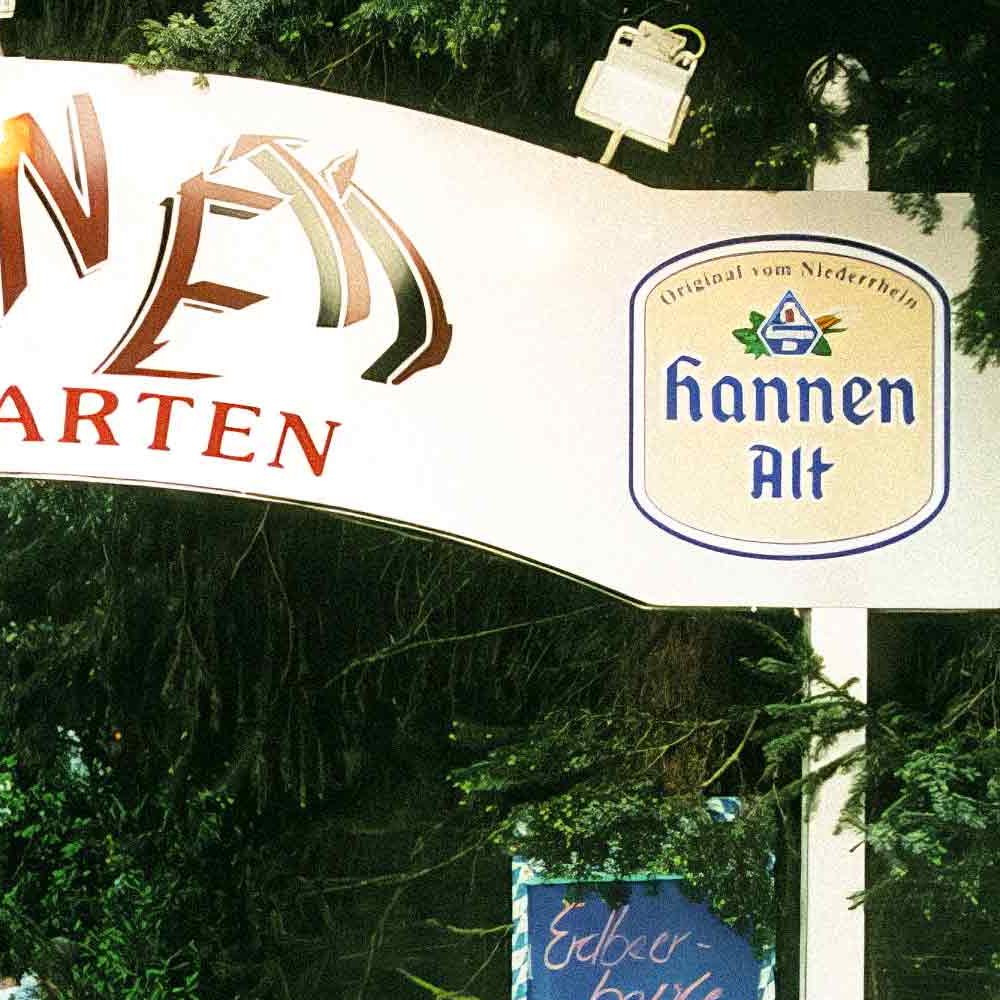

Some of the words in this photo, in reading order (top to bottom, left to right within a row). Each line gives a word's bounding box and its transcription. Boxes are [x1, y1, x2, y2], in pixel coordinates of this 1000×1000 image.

[660, 264, 742, 305] Original
[752, 264, 792, 277] vom
[801, 261, 920, 310] Niederrhein
[749, 443, 835, 499] Alt
